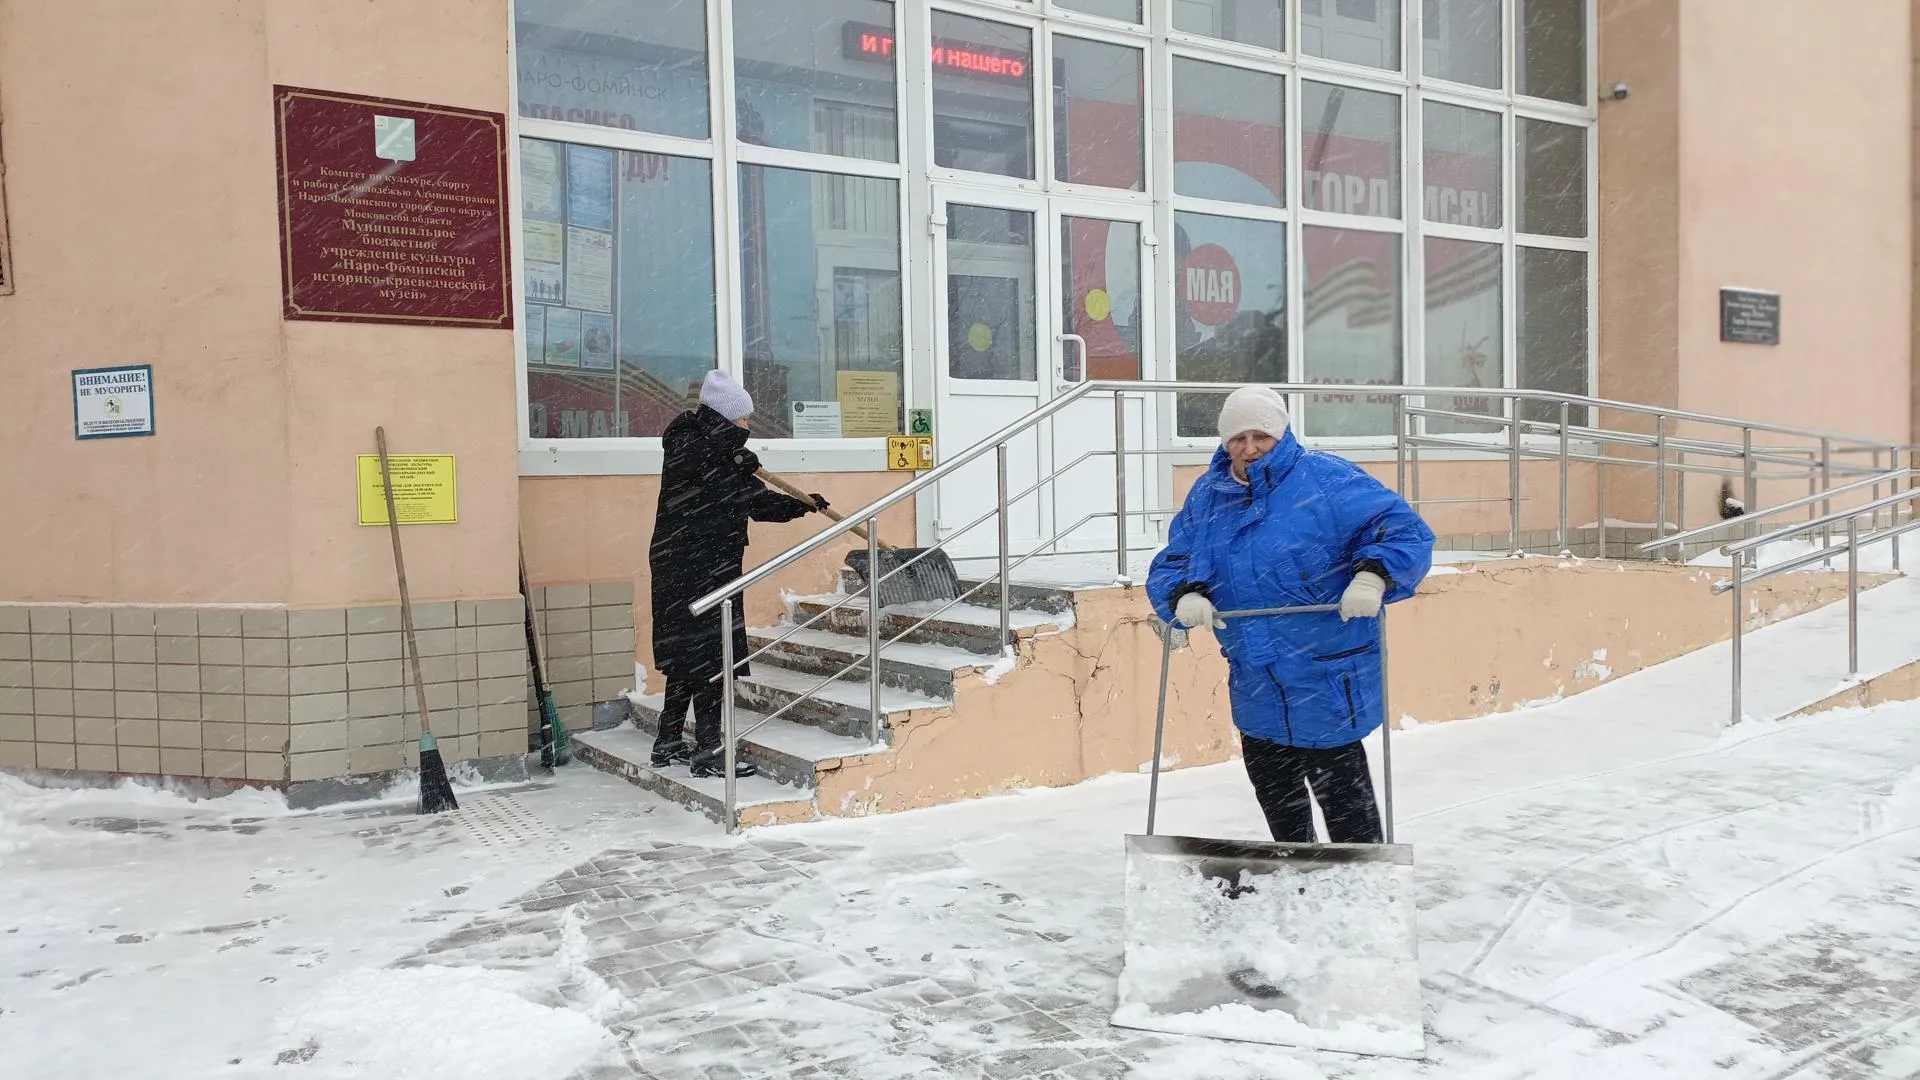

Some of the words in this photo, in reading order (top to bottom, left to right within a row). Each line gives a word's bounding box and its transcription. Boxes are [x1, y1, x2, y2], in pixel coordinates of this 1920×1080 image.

[947, 48, 1025, 77] нашего
[320, 166, 365, 179] Комитет
[385, 175, 435, 187] культуре,
[437, 180, 471, 191] спорту
[293, 179, 300, 187] и
[303, 180, 339, 190] работе
[348, 184, 411, 197] молодежью
[415, 189, 496, 205] Администрации
[298, 191, 398, 208] Наро-Фоминского
[400, 201, 456, 213] городского
[458, 208, 492, 217] округа
[344, 208, 409, 222] Московской
[412, 215, 452, 226] области
[342, 218, 456, 239] Муниципальное
[362, 233, 438, 250] бюджетное
[321, 246, 407, 261] учреждение
[410, 252, 476, 268] культуры
[334, 258, 466, 277] «Наро-Фоминский
[312, 271, 487, 291] историко-краеведческий
[1186, 267, 1234, 303] МАЯ
[379, 289, 426, 301] музей»
[80, 372, 146, 386] ВНИМАНИЕ!
[80, 388, 92, 397] НЕ
[95, 384, 147, 395] МУСОРИТЬ!
[561, 409, 630, 438] МАЯ
